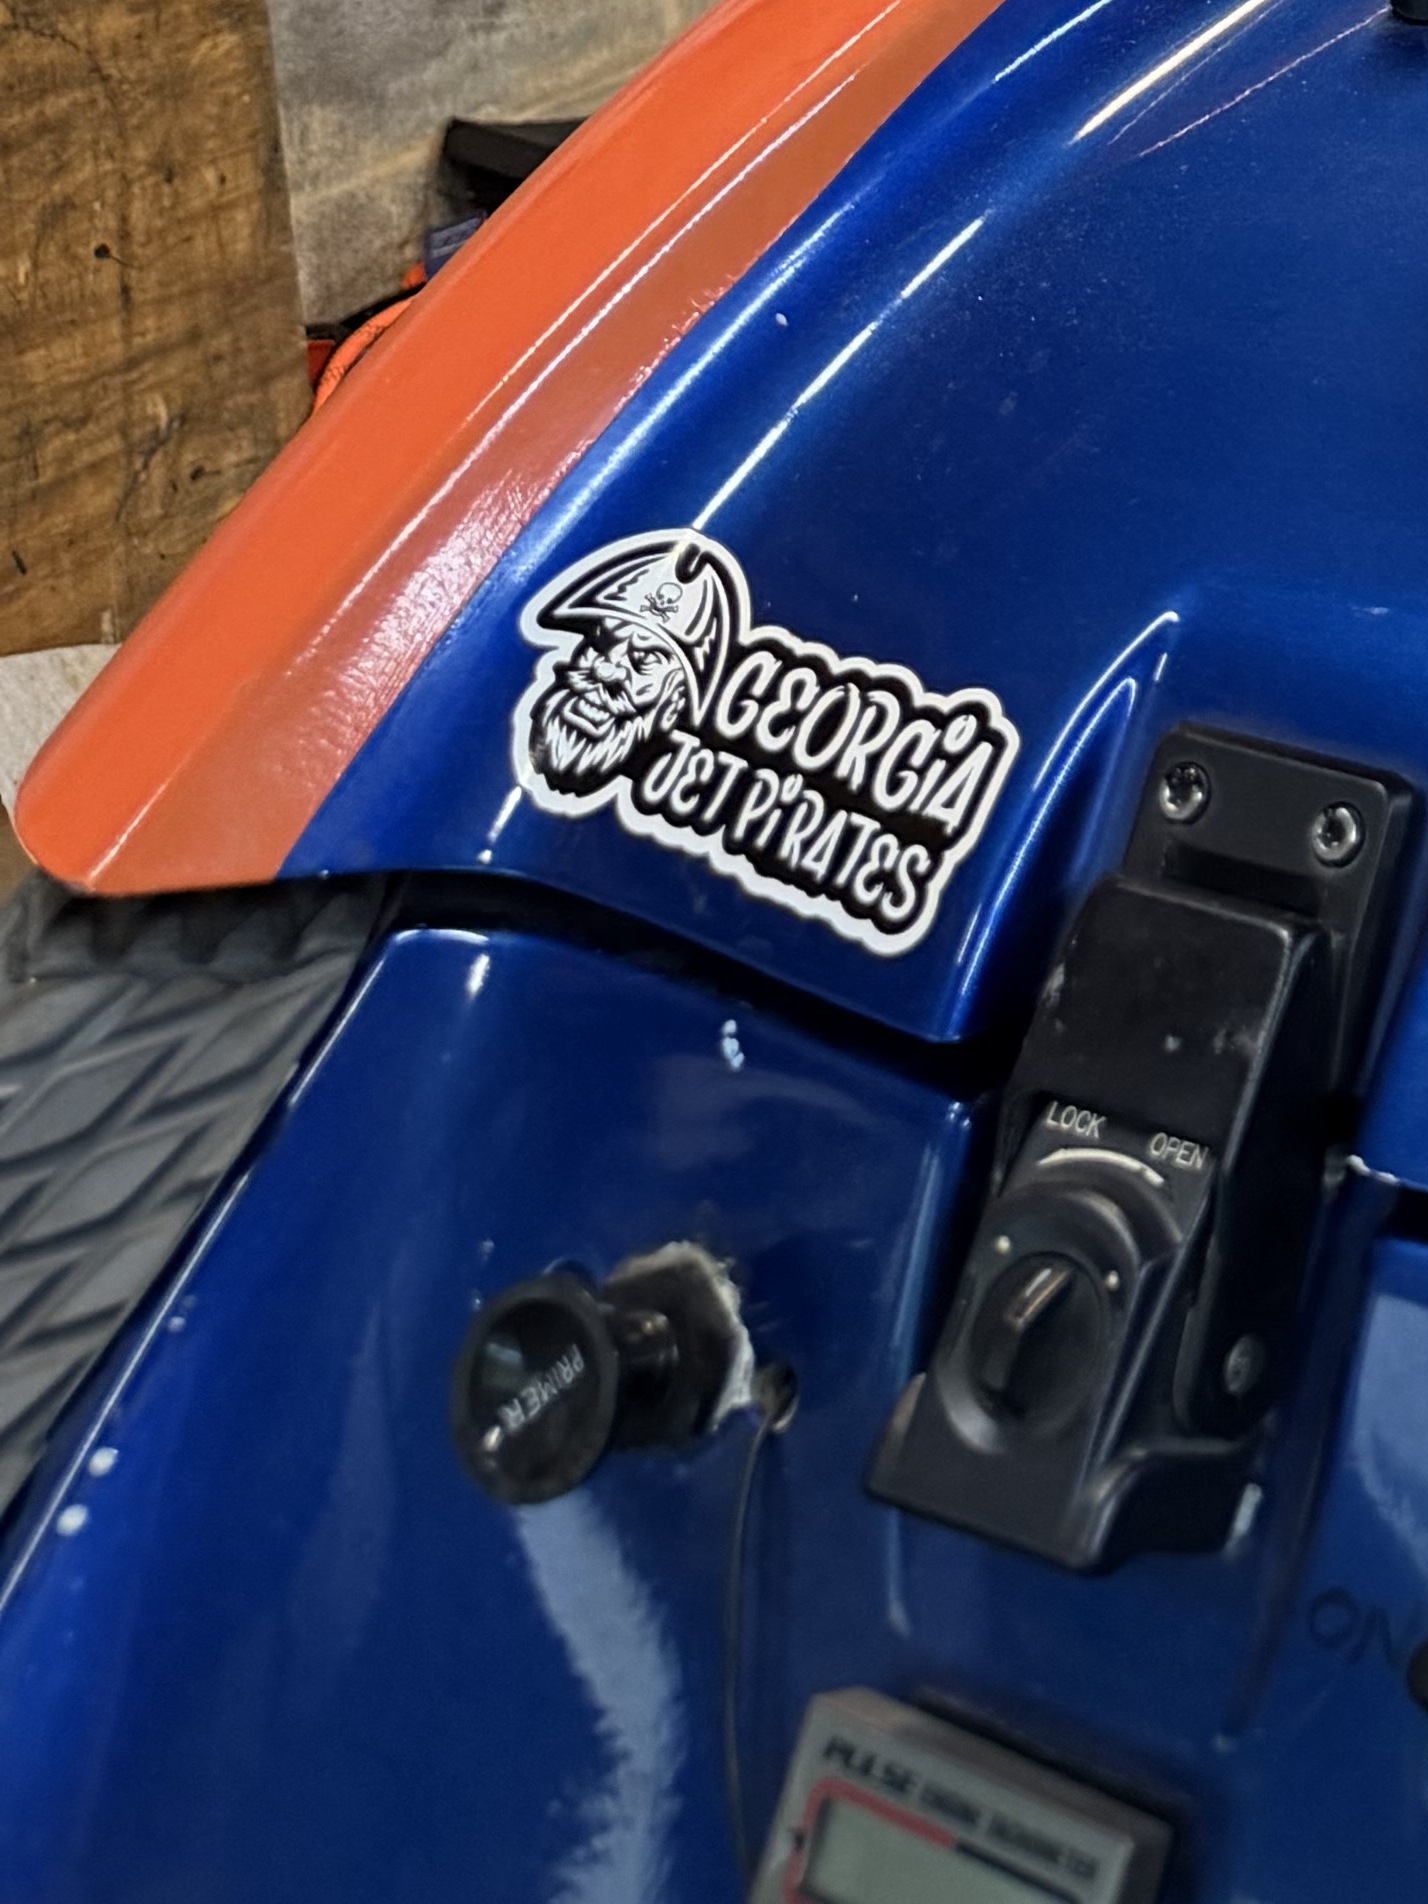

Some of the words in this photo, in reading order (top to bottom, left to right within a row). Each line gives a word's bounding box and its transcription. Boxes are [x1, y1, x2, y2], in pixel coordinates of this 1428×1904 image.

[716, 650, 993, 835] GEORGIA
[643, 729, 748, 822] JET
[734, 768, 930, 921] PIRATES
[1046, 1100, 1107, 1139] LOCK
[1150, 1132, 1210, 1170] OPEN
[499, 1342, 584, 1430] PRIMER
